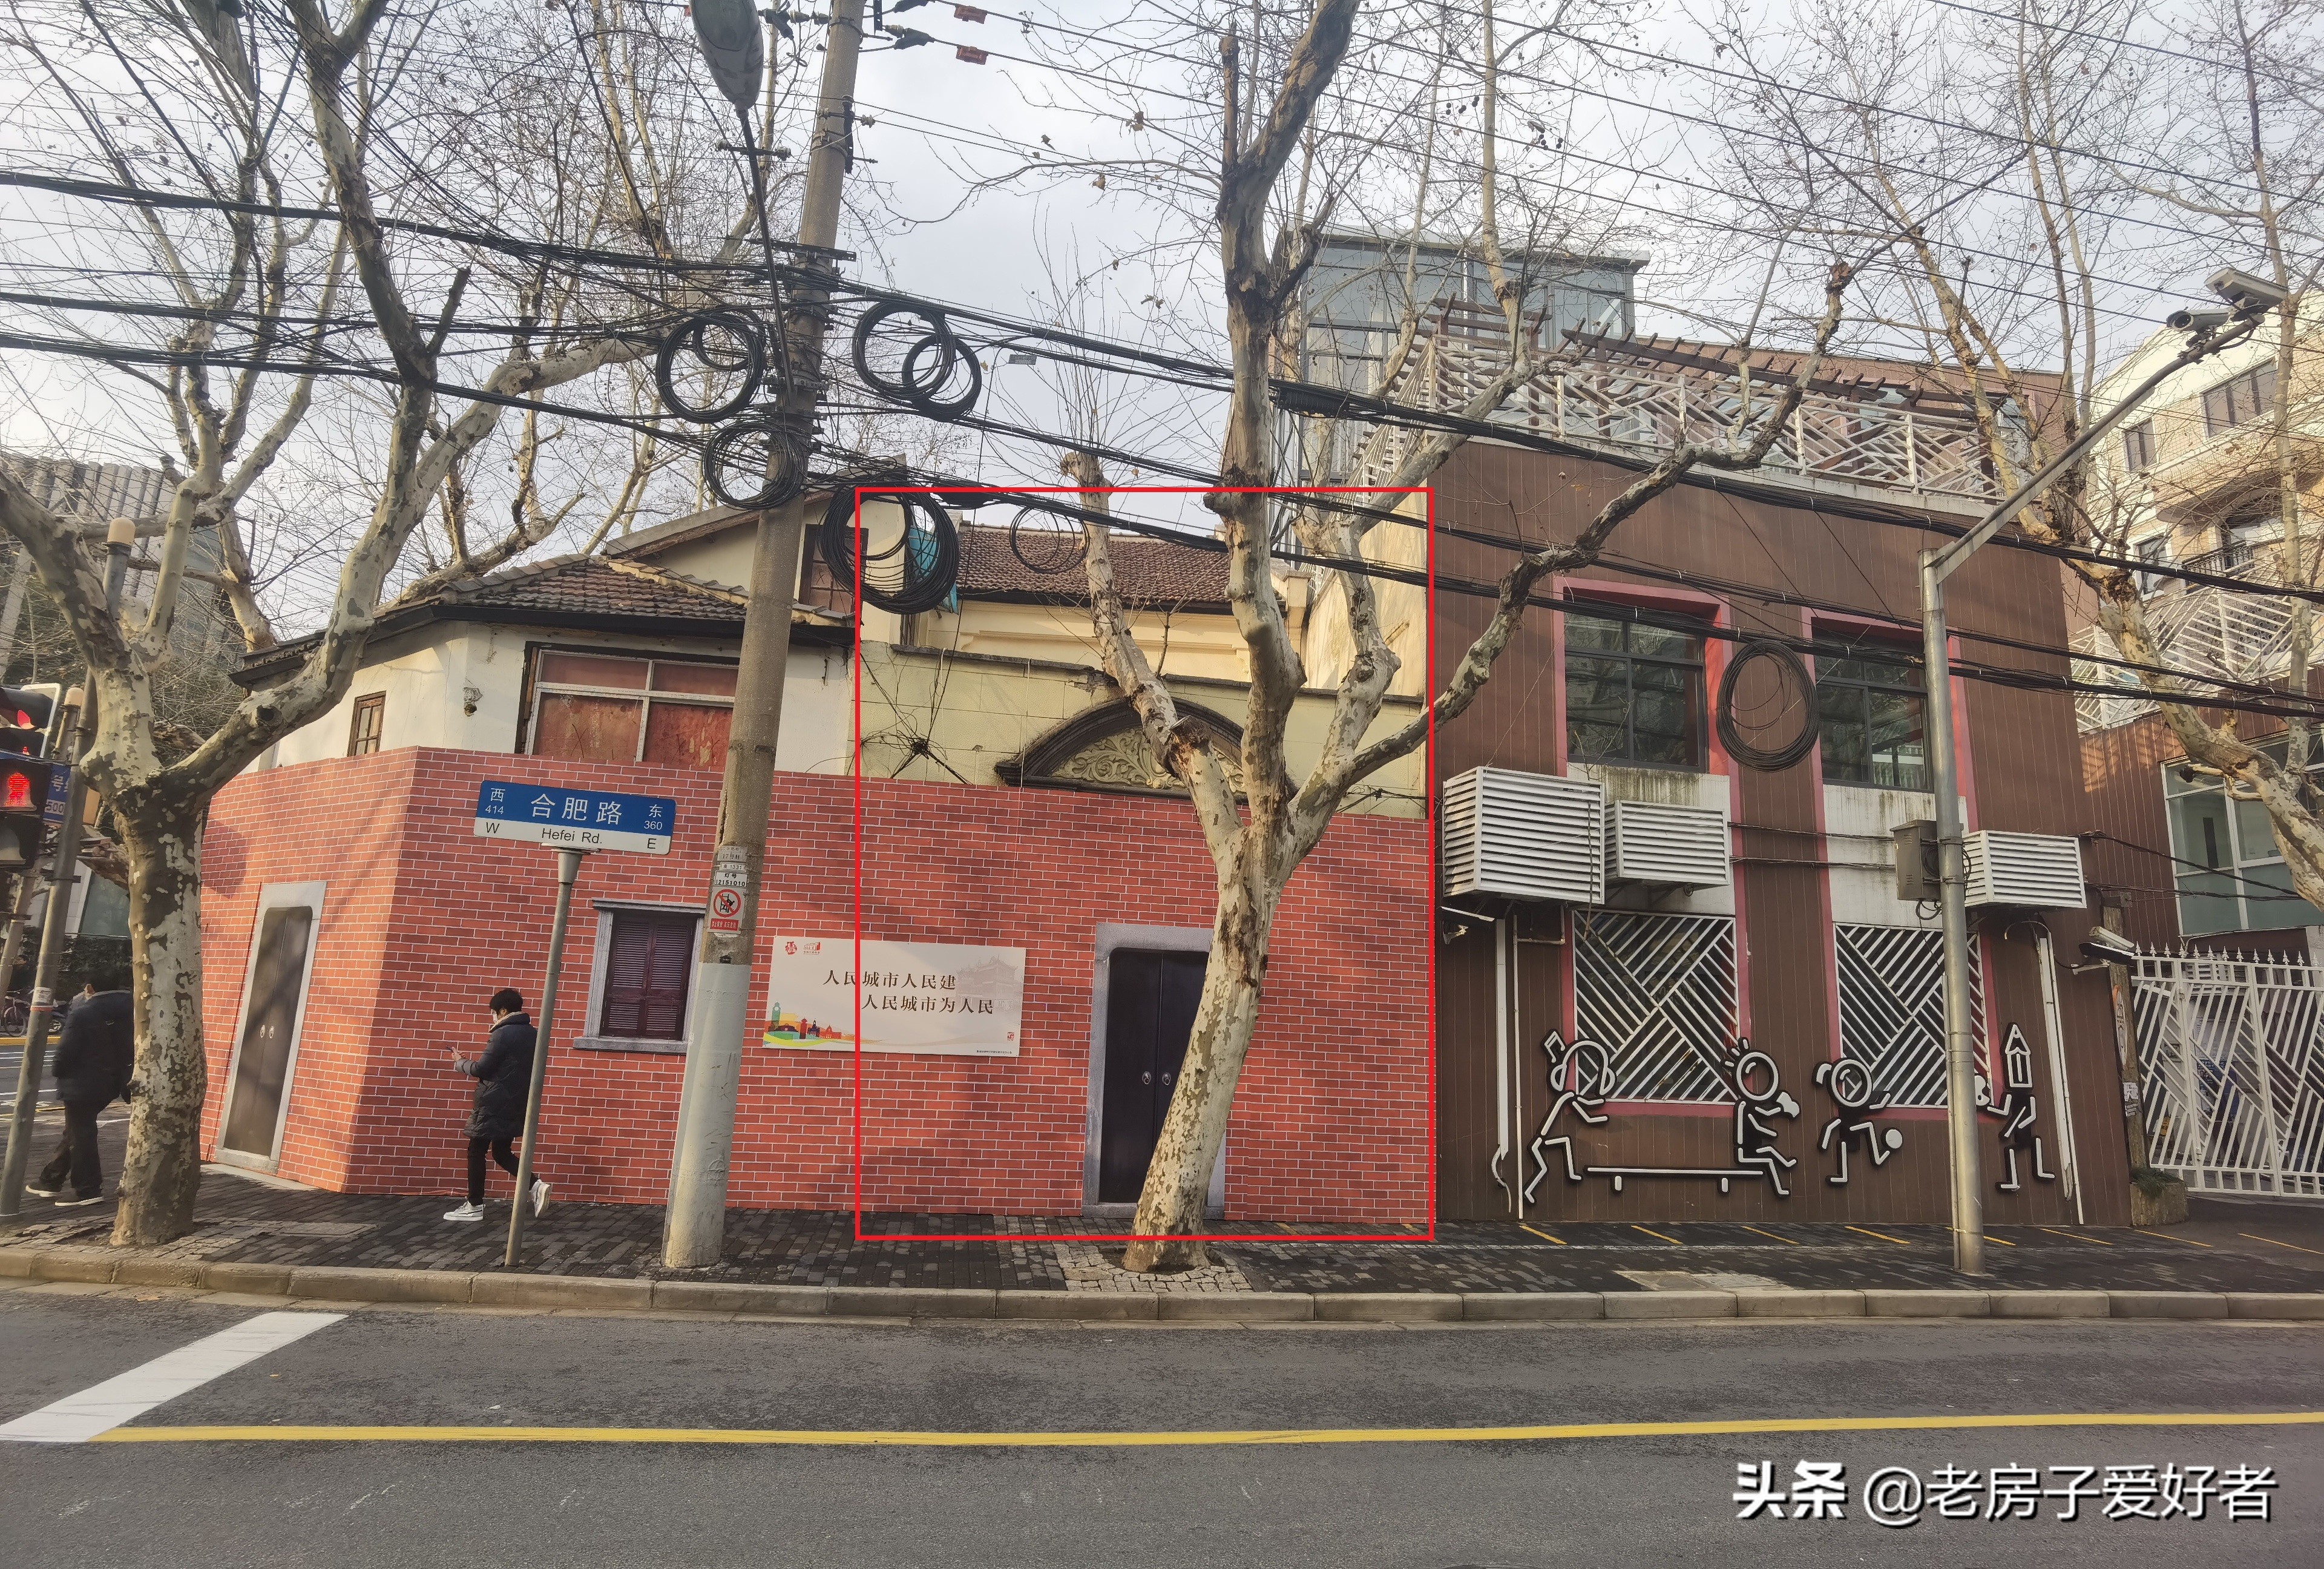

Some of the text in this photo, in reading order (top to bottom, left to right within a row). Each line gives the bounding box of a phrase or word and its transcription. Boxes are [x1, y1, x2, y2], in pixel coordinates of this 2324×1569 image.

[490, 788, 506, 803] 西
[485, 805, 504, 815] 414
[531, 793, 623, 825] 合肥路
[649, 804, 663, 818] 东
[486, 822, 500, 834] W
[644, 820, 663, 831] 360
[542, 827, 603, 844] Hefei Rd.
[647, 838, 657, 849] E
[822, 970, 956, 990] 人民城市人民建
[861, 994, 993, 1015] 人民城市为人民
